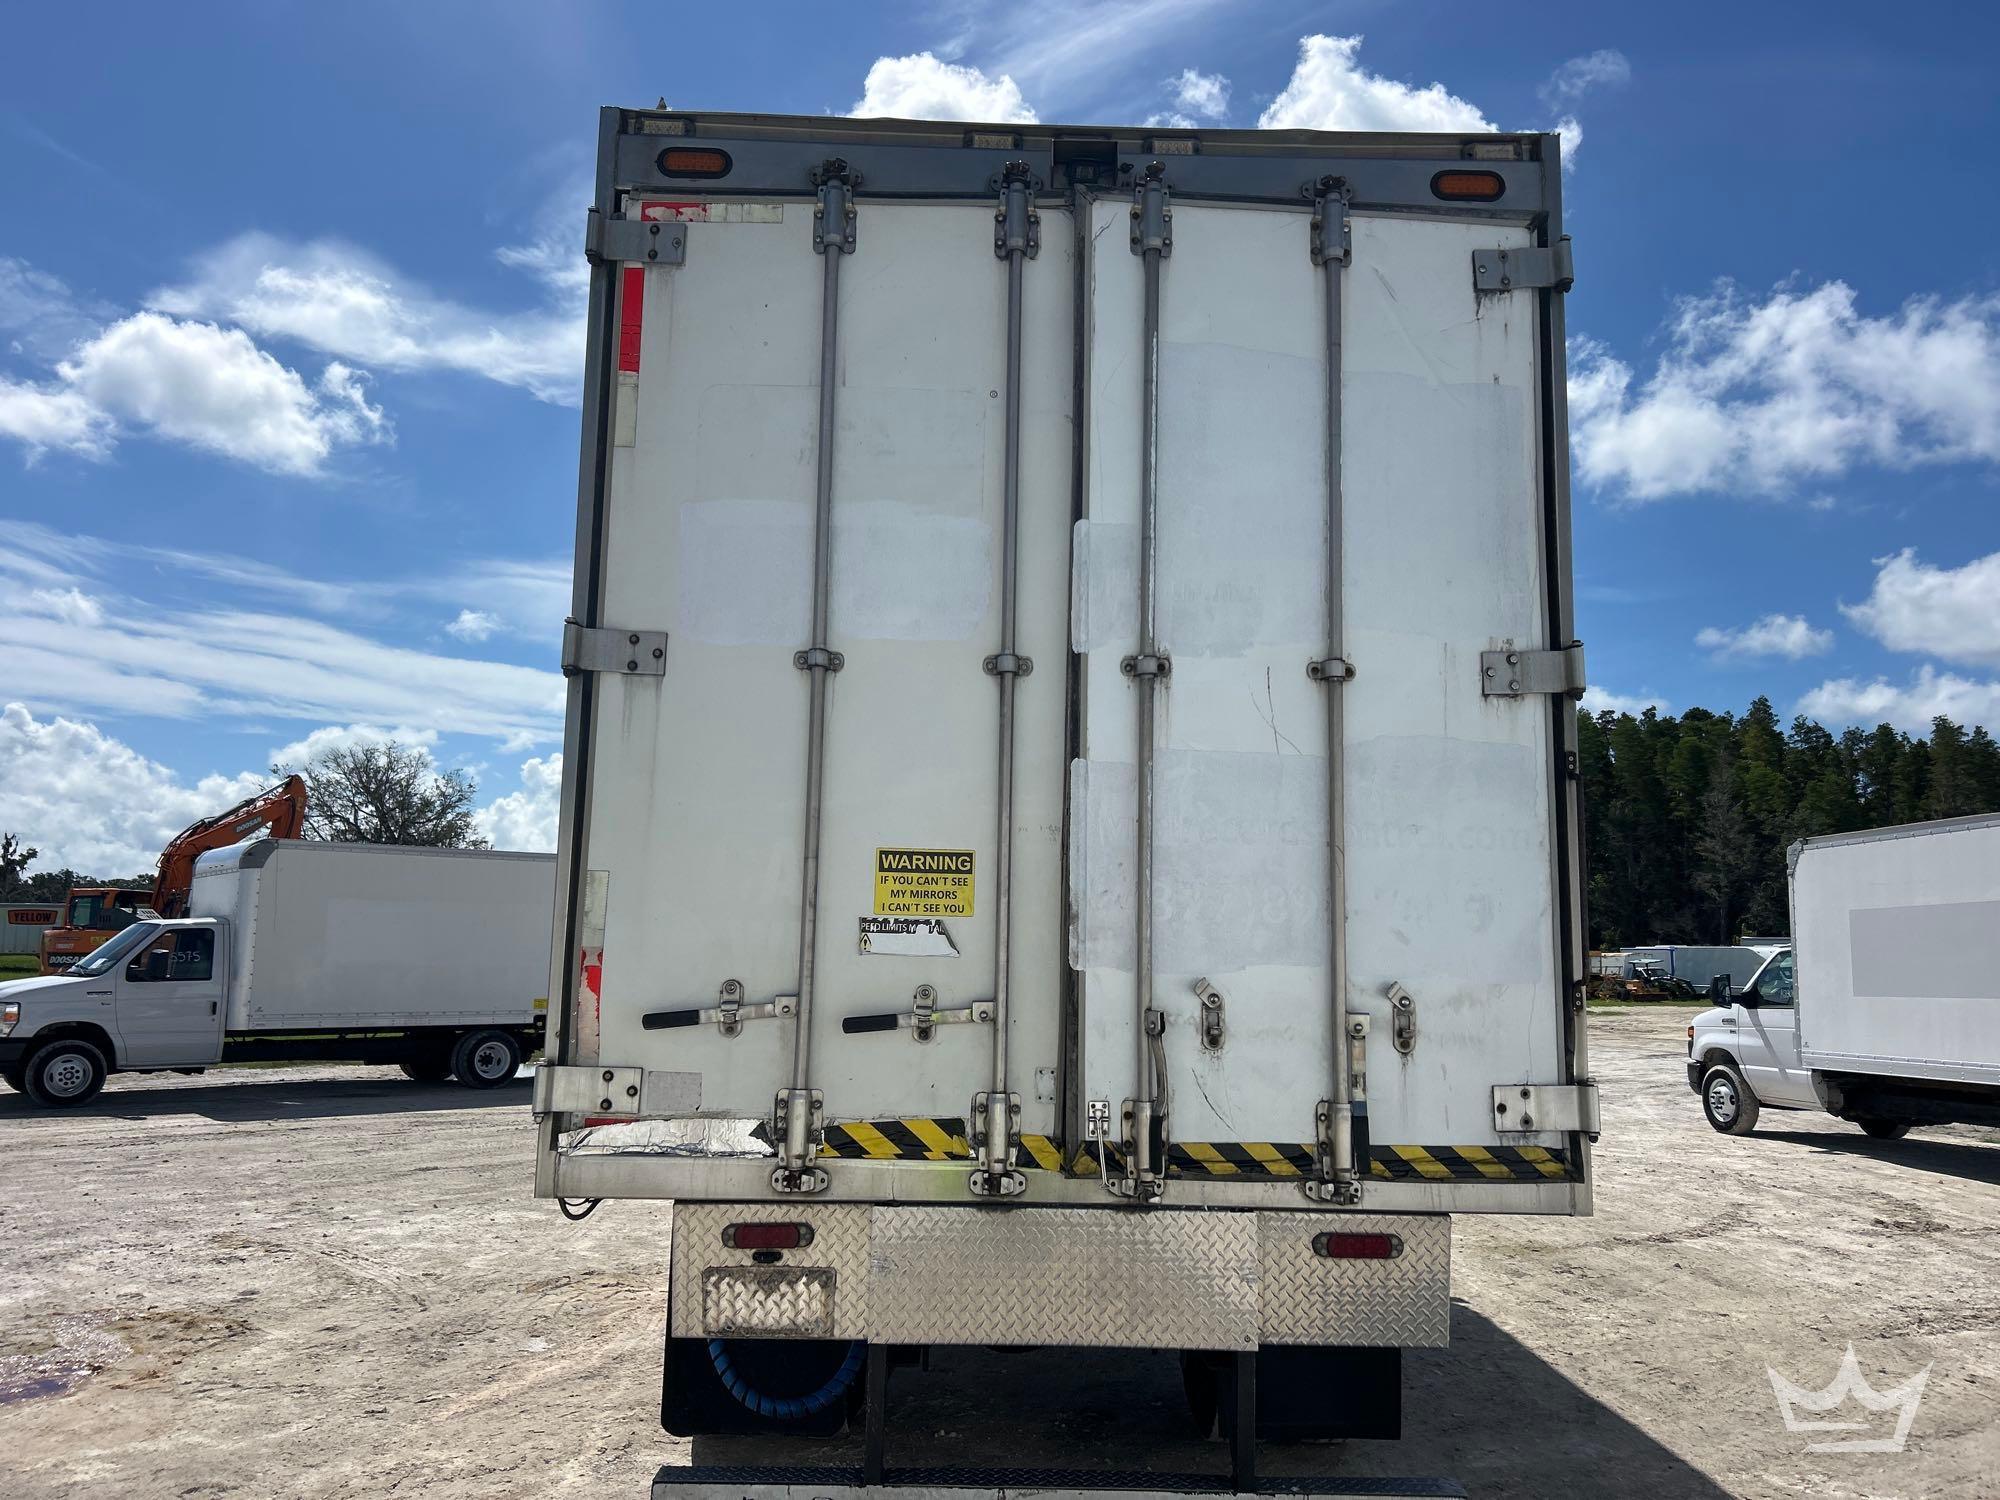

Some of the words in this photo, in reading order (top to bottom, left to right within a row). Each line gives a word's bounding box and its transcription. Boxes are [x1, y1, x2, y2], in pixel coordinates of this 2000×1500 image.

[882, 854, 971, 871] WARNING
[880, 875, 889, 885] IF
[892, 876, 914, 885] YOU
[916, 876, 949, 886] CAN'T
[951, 877, 969, 887] SEE
[890, 889, 907, 899] MY
[909, 889, 958, 900] MIRRORS
[882, 902, 885, 911] I
[888, 902, 920, 912] CAN'T
[923, 903, 941, 913] SEE
[943, 904, 965, 913] YOU
[15, 911, 51, 922] YELLOW
